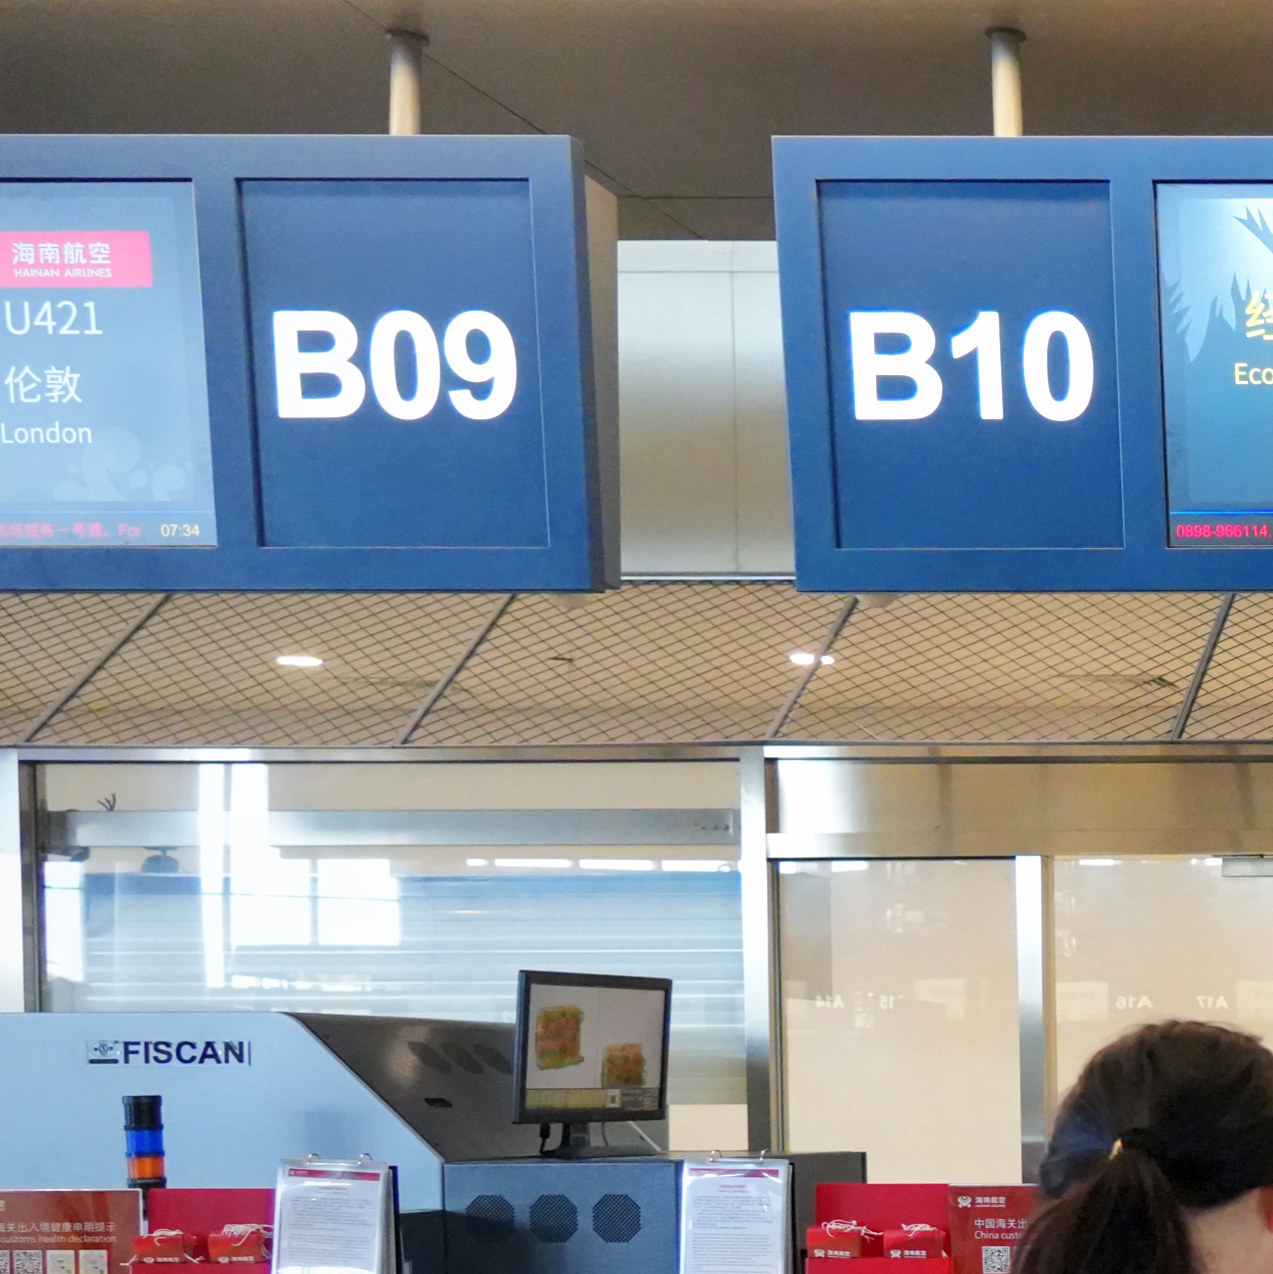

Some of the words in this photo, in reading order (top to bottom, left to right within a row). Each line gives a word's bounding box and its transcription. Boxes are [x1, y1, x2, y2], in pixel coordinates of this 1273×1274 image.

[12, 242, 112, 264] 海南航空
[14, 268, 60, 278] HAINAN
[64, 268, 112, 278] AIRLINES
[272, 310, 518, 420] B09
[847, 309, 1095, 422] B10
[5, 366, 83, 403] 伦敦
[1, 421, 92, 443] London
[161, 523, 201, 537] 07:34
[122, 1040, 244, 1064] FISCAN
[974, 1230, 999, 1239] China
